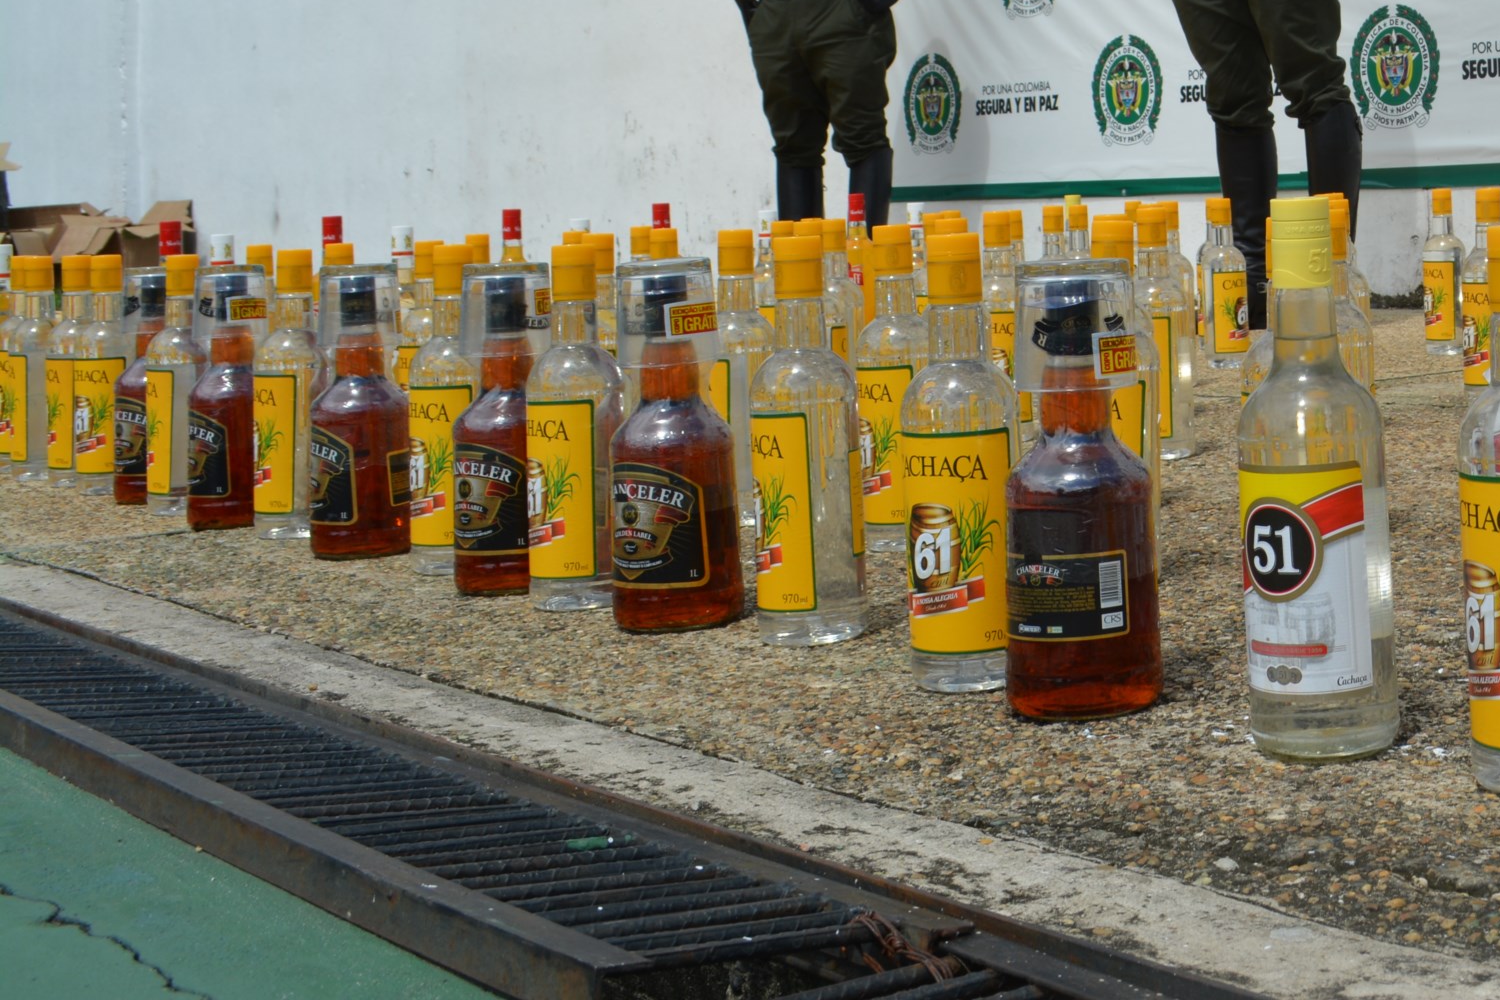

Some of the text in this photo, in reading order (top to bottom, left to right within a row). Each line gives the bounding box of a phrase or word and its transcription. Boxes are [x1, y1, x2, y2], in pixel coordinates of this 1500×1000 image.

[1472, 41, 1492, 55] POR
[914, 528, 951, 580] 61
[1253, 525, 1301, 575] 51
[690, 569, 698, 578] 1L
[1016, 563, 1060, 578] CHANCELER
[1103, 614, 1121, 625] CRS
[1466, 594, 1495, 654] 61
[1337, 674, 1368, 687] Cachaça
